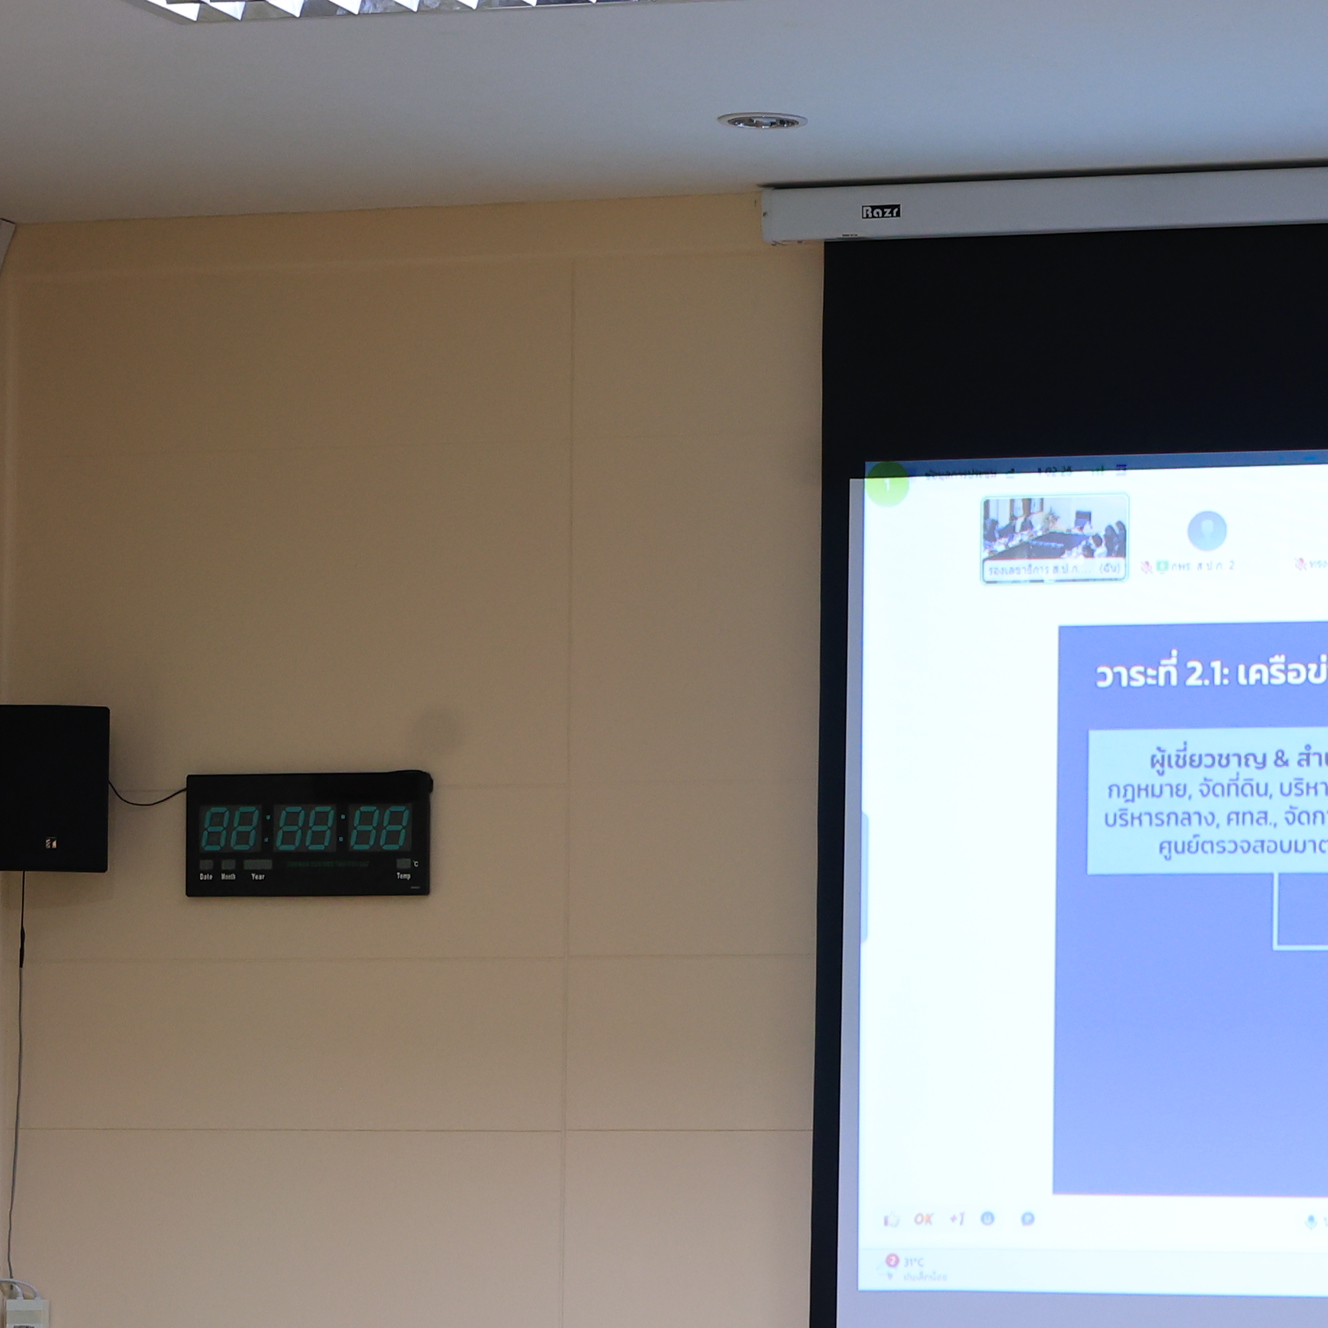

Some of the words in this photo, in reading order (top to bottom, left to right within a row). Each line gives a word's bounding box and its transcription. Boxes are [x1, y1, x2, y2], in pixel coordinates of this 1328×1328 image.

[863, 206, 899, 218] Razr
[988, 562, 1049, 577] รองเลขาธิการ
[1099, 561, 1122, 576] (ฉัน)
[1096, 649, 1179, 688] วาระที่
[1185, 659, 1230, 687] 2.1:
[1150, 741, 1268, 777] ผู้เชี่ยวชาญ
[1273, 749, 1290, 769] &
[1107, 781, 1192, 804] กฎหมาย,
[1198, 771, 1273, 802] จัดที่ดิน,
[1104, 807, 1221, 830] บริหารกลาง,
[1226, 809, 1278, 829] ศทส.,
[199, 873, 213, 881] Date
[251, 873, 265, 881] Year
[396, 872, 411, 880] Temp
[914, 1212, 934, 1226] OK
